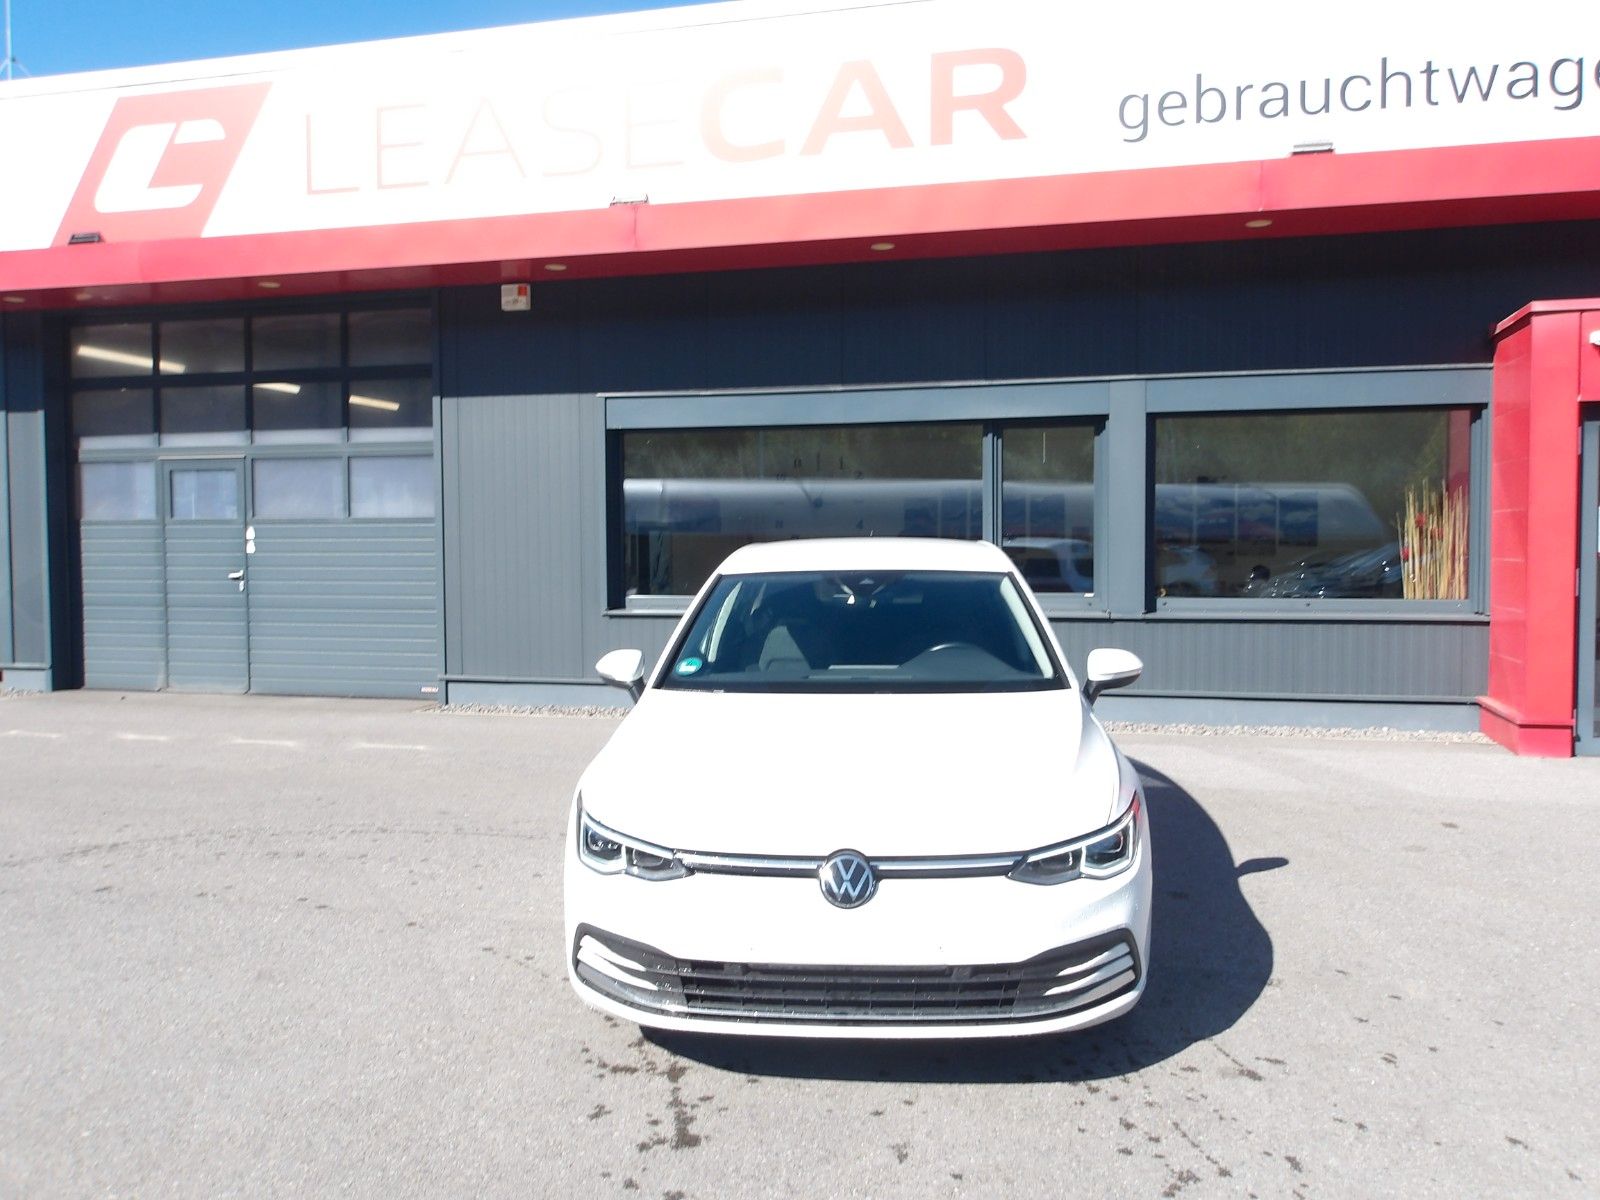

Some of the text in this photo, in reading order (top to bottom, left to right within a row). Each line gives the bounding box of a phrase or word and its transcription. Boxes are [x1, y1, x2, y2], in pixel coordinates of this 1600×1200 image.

[306, 47, 1027, 195] LEASECAR
[1118, 57, 1600, 142] gebrauchtwag
[821, 854, 873, 906] VW
